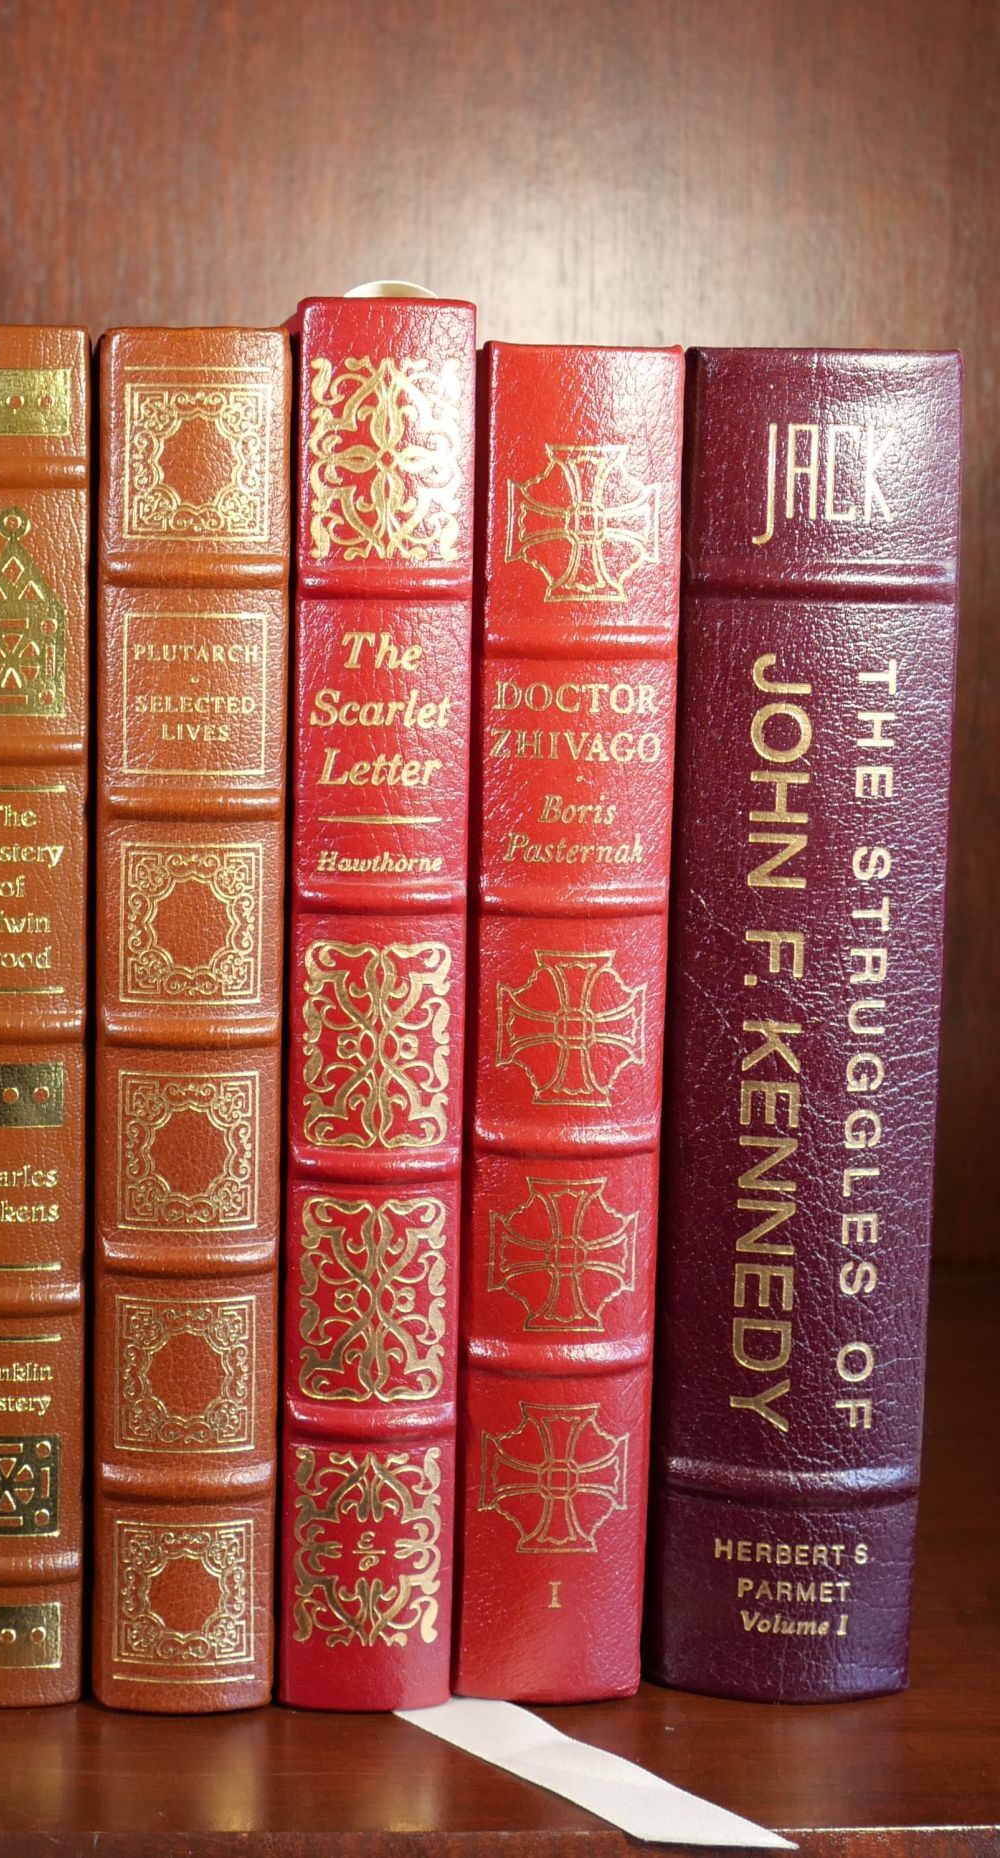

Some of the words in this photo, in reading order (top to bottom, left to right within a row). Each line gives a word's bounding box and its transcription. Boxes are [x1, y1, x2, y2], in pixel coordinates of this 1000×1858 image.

[752, 422, 898, 544] JACK
[132, 643, 258, 664] PLUTARCH
[341, 630, 422, 671] The
[135, 695, 256, 714] SELECTED
[309, 688, 451, 729] Scarlet
[492, 678, 659, 715] DOCTOR
[161, 723, 231, 742] LIVES
[489, 728, 662, 763] ZHIVAGO
[854, 657, 899, 800] THE
[317, 748, 443, 788] Letter
[747, 653, 813, 891] JOHN
[537, 793, 617, 826] Boris
[316, 850, 443, 873] Hawthorne
[503, 831, 644, 865] Pasternak
[743, 929, 806, 987] F.
[838, 844, 893, 1296] STRUGGLES
[728, 1019, 803, 1433] KENNEDY
[834, 1340, 875, 1429] OF
[714, 1537, 846, 1566] HERBERT
[548, 1581, 562, 1608] I
[737, 1577, 850, 1602] PARMET
[740, 1610, 830, 1636] Volume
[836, 1614, 849, 1636] I
